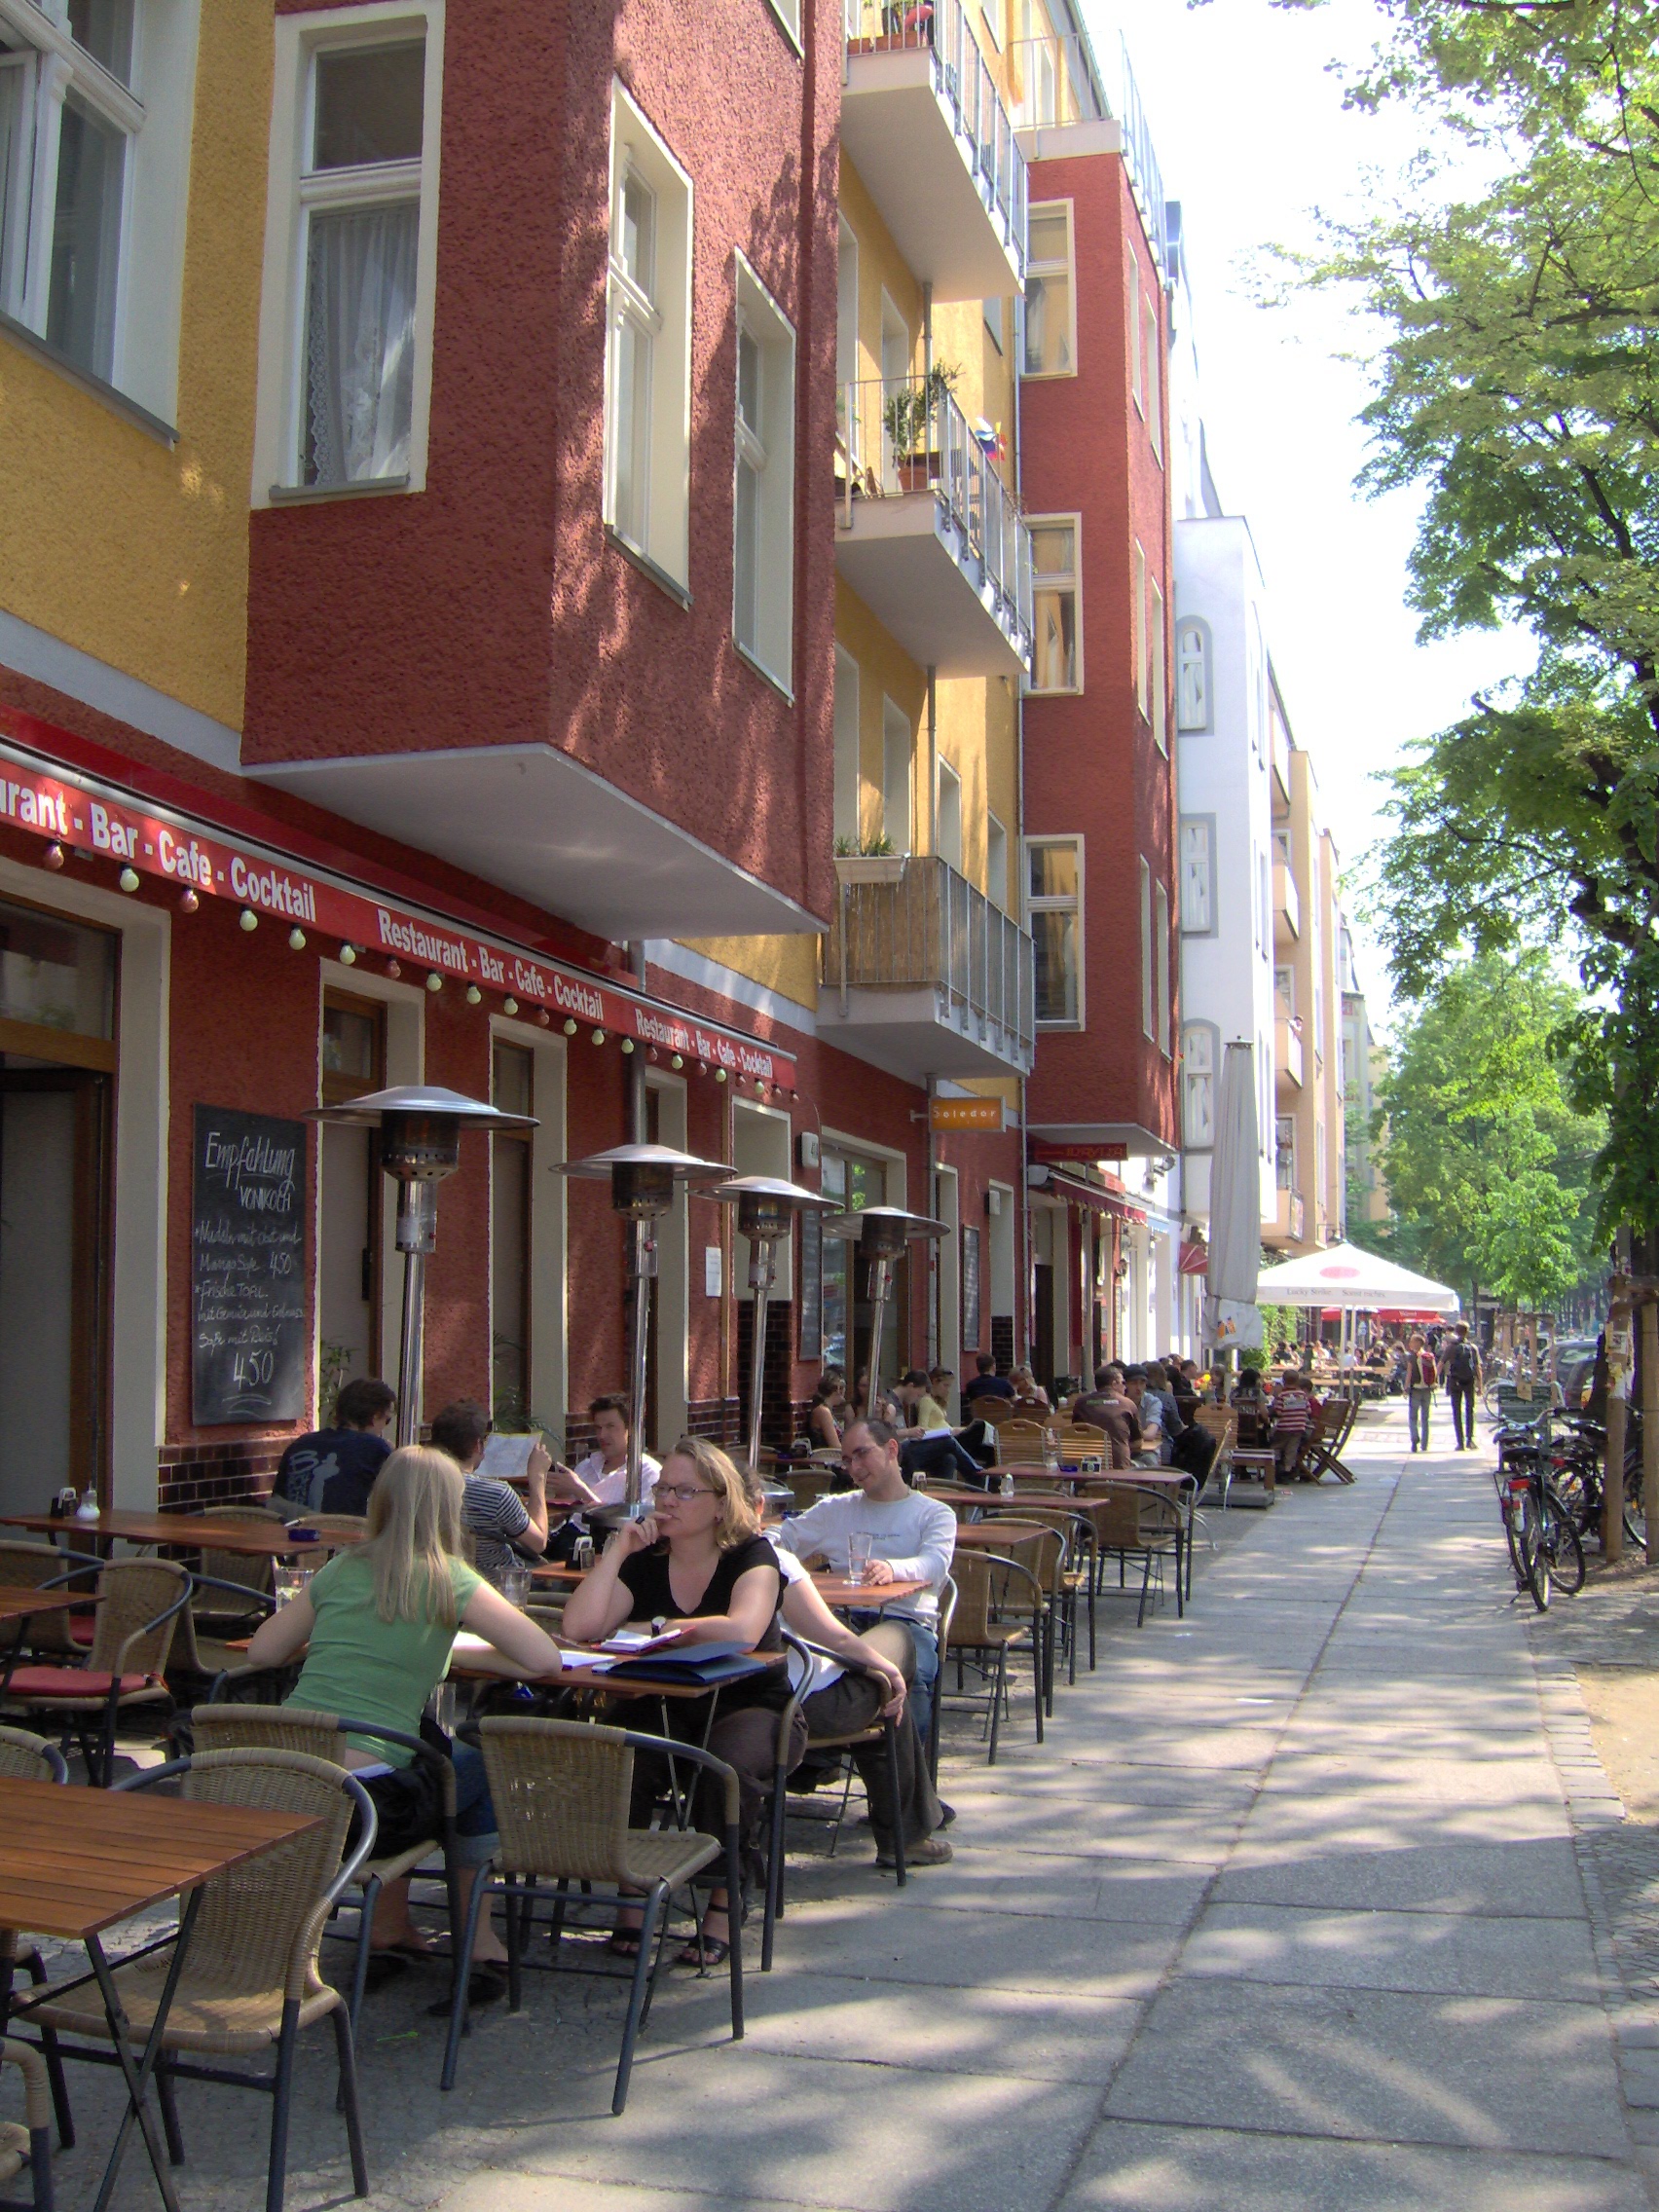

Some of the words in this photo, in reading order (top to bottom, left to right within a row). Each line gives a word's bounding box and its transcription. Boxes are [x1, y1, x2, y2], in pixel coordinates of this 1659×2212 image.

[90, 802, 138, 860] Bar
[158, 830, 212, 887] Cafe
[230, 856, 317, 923] Cocktail
[377, 908, 468, 974] Restaurant
[478, 945, 505, 984] Bar
[515, 959, 545, 999] Cafe
[553, 975, 605, 1022] Cocktail
[635, 1008, 690, 1051] Restaurant
[695, 1030, 712, 1059] Bar
[717, 1039, 736, 1068] Cafe
[740, 1047, 773, 1079] Cocktail
